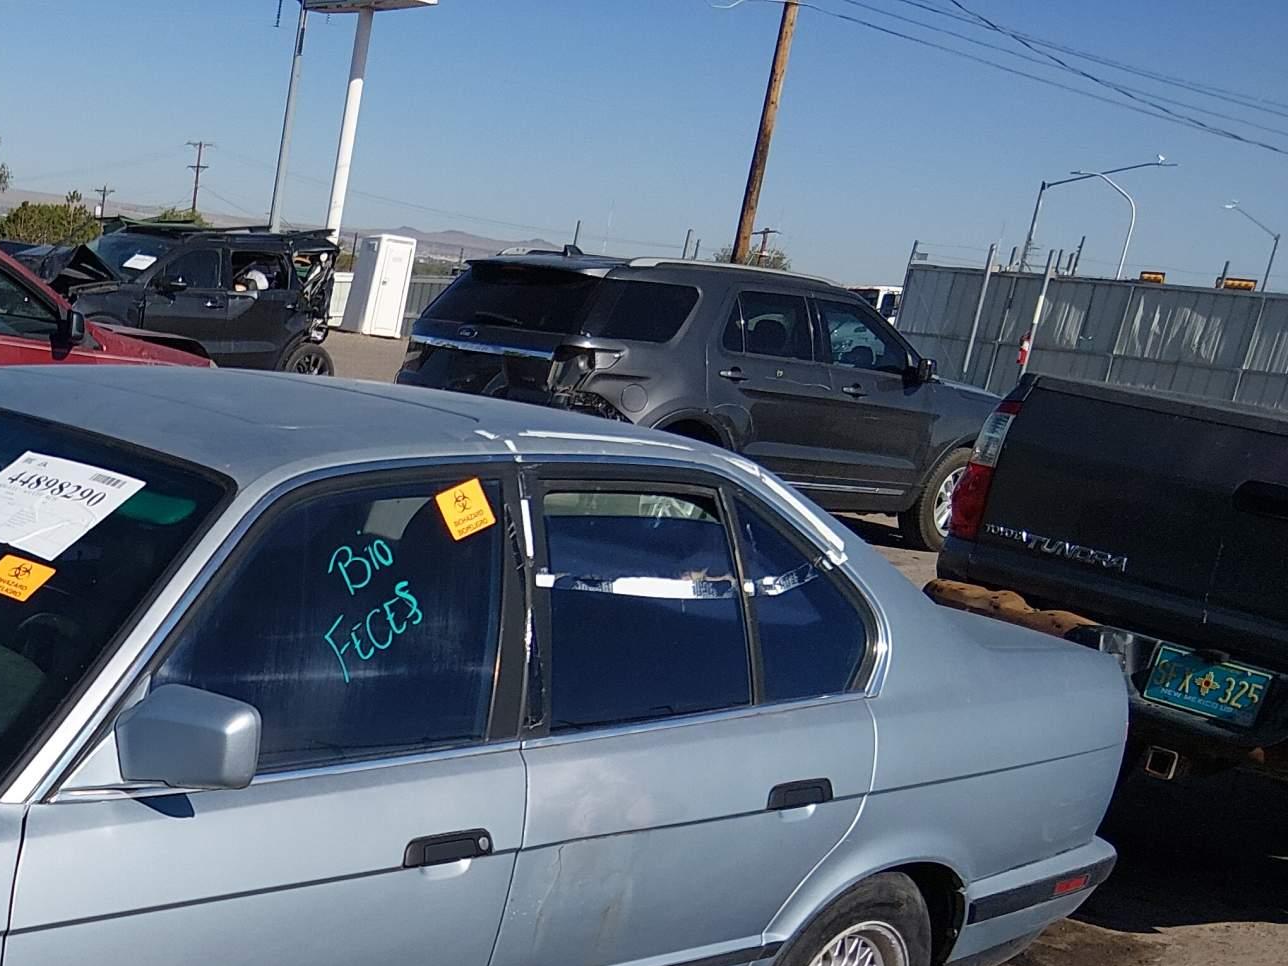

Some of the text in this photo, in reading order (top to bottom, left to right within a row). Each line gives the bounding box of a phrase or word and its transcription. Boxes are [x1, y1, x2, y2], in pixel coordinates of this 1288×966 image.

[8, 470, 107, 507] 44898290
[1027, 533, 1128, 573] TUNDRA
[323, 580, 423, 684] FECES
[1160, 687, 1182, 699] NEW
[1183, 694, 1219, 710] MEXICO
[1218, 677, 1265, 709] 325
